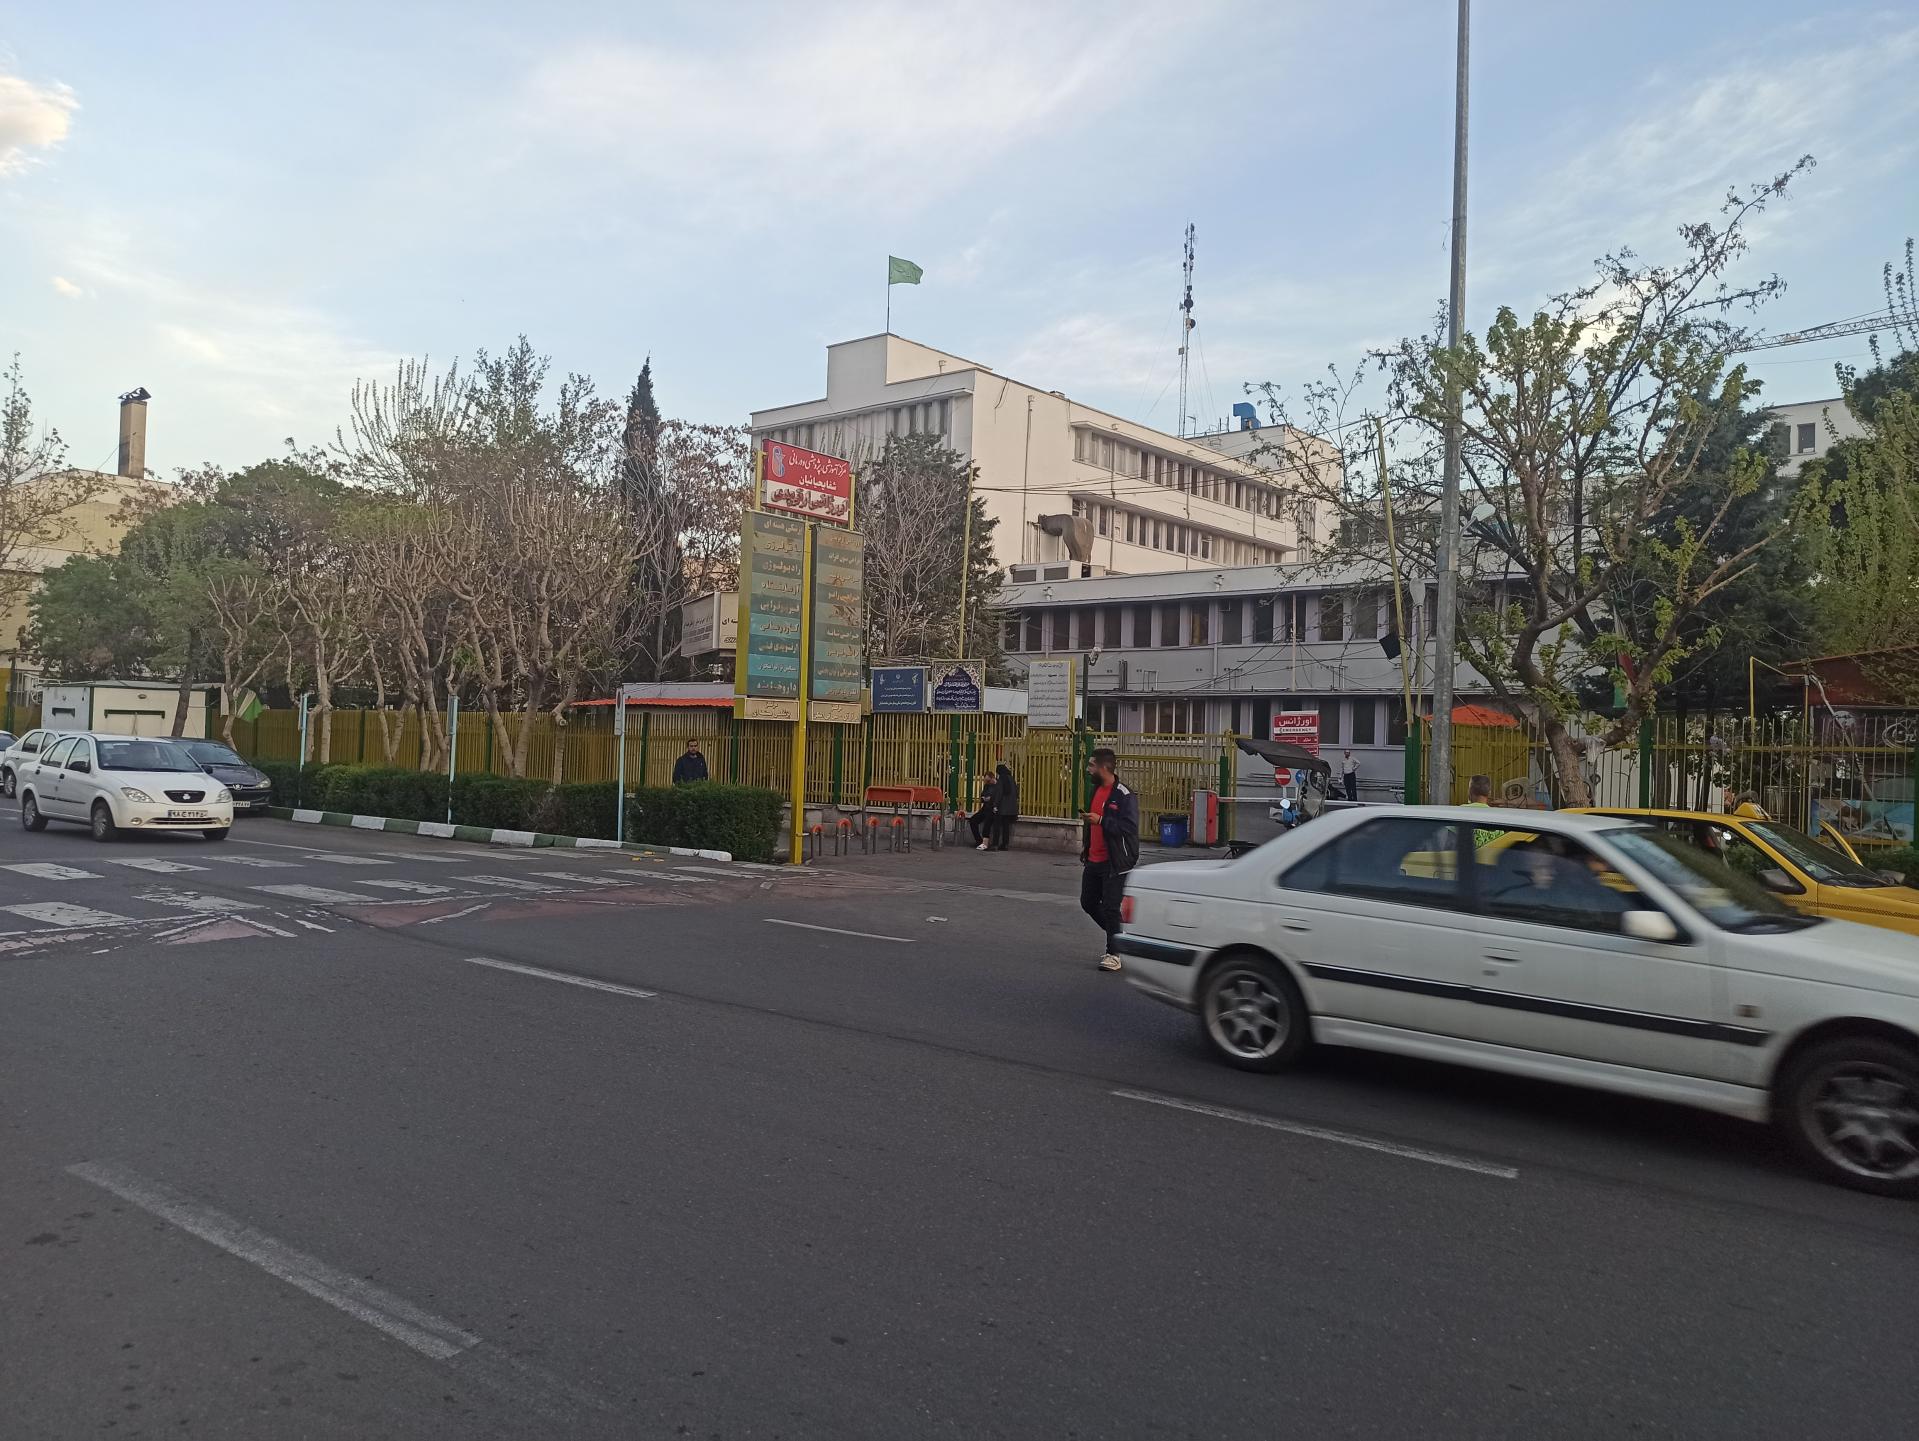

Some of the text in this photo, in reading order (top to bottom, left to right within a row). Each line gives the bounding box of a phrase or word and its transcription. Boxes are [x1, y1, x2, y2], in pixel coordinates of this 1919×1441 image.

[788, 450, 803, 465] درمانی
[805, 453, 821, 475] پژوهشی
[839, 462, 847, 477] مرکز
[771, 488, 848, 516] اورژانس ارتوپدی
[756, 680, 798, 694] داروخانه
[1279, 716, 1312, 727] اورژانس
